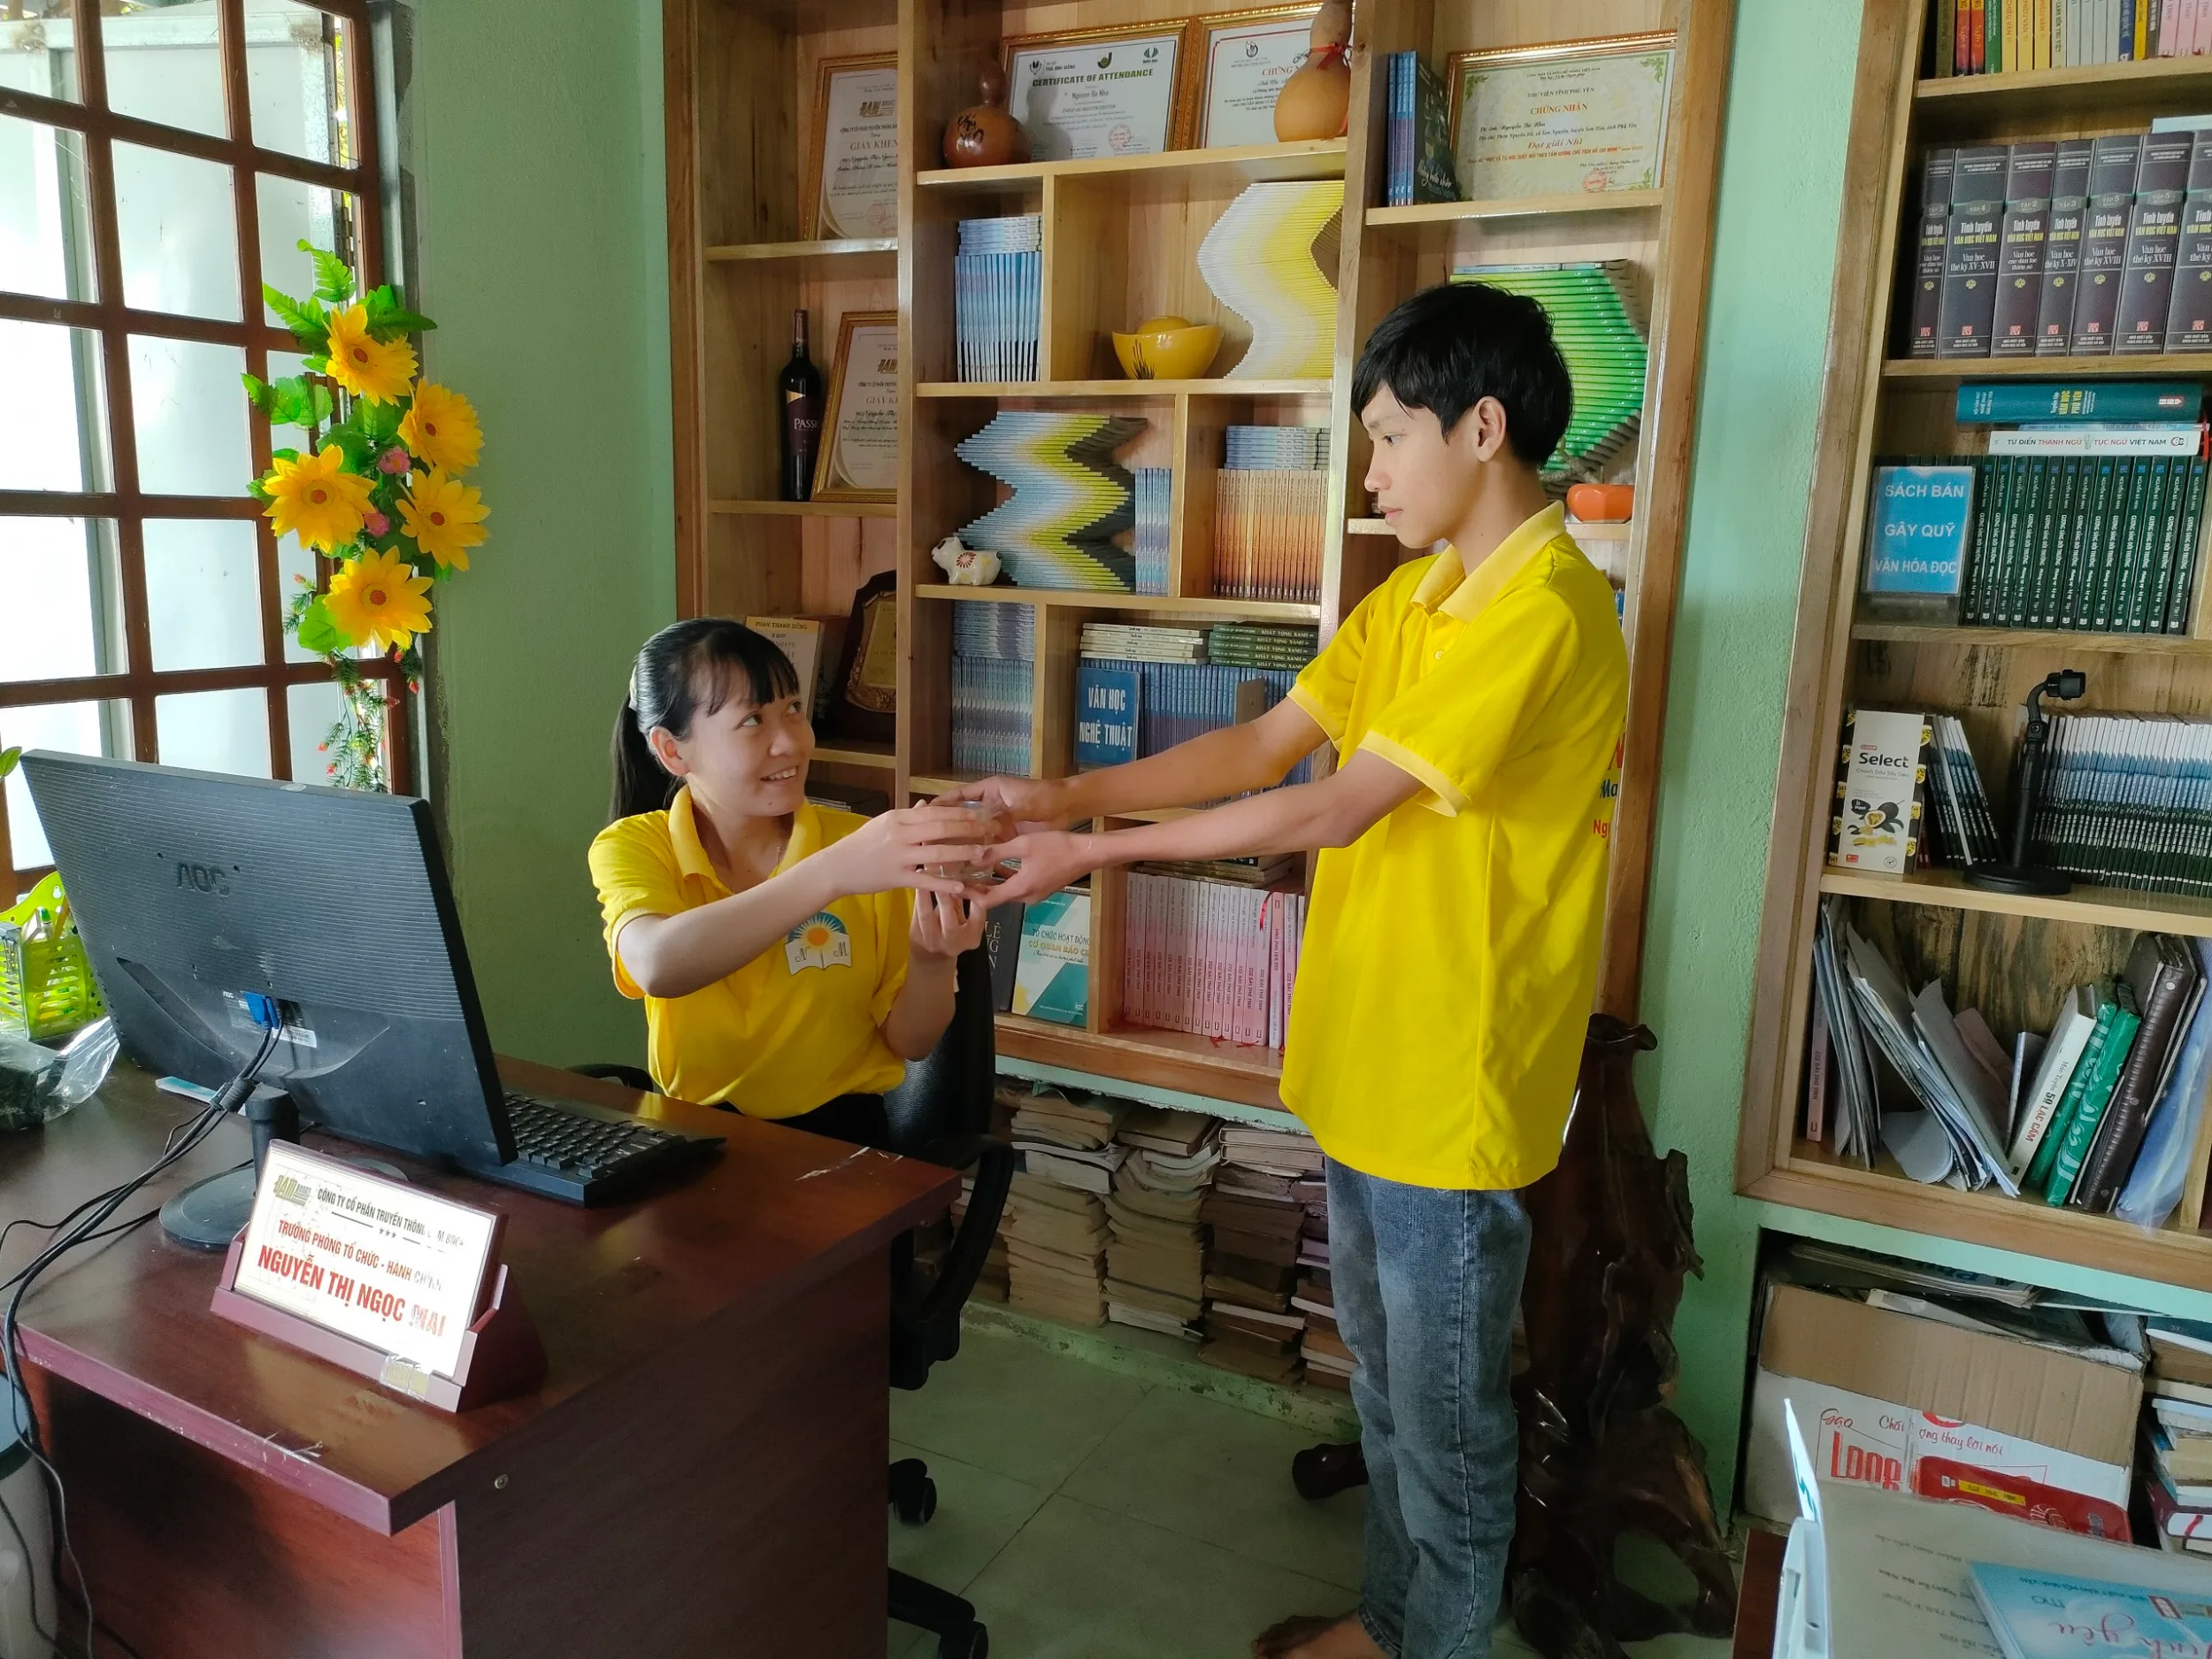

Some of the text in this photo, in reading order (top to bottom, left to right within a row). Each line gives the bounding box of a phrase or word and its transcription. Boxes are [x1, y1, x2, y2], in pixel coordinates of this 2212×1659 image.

[1032, 69, 1154, 88] CERTIFICATE OF ATTENDANCE
[1530, 103, 1562, 115] CHỨNG
[2129, 437, 2147, 446] VIỆT
[1885, 480, 1964, 499] SÁCH BÁN
[1885, 521, 1956, 538] GÂY QUỸ
[1875, 557, 1957, 577] VĂN HÓA ĐỌC
[1088, 682, 1108, 709] VĂN
[1109, 687, 1126, 713] HỌC
[1079, 718, 1133, 752] NGHỆ THUẬT
[1858, 752, 1909, 768] Select
[177, 861, 230, 897] AOC
[1041, 928, 1057, 940] CHỨC
[1057, 932, 1074, 944] HOẠT
[1040, 942, 1062, 953] QUAN
[1063, 944, 1079, 955] BÁO
[317, 1187, 337, 1204] CÔNG
[336, 1194, 346, 1207] TY
[346, 1196, 357, 1211] CỔ
[356, 1202, 376, 1218] PHẦN
[376, 1209, 403, 1228] TRUYỀN
[403, 1217, 426, 1235] THÔN
[278, 1220, 311, 1243] TRƯỞNG
[311, 1232, 342, 1256] PHÒNG
[342, 1240, 357, 1258] TỔ
[355, 1247, 380, 1269] CHỨC
[386, 1259, 412, 1281] HÀNH
[257, 1245, 325, 1290] NGUYỄN
[327, 1267, 355, 1308] THỊ
[356, 1283, 406, 1323] NGỌC
[1821, 1408, 1854, 1428] Gạo
[1919, 1428, 1938, 1445] ợng
[1941, 1431, 1963, 1451] thay
[1966, 1435, 1984, 1451] lời
[1985, 1442, 2003, 1456] nói
